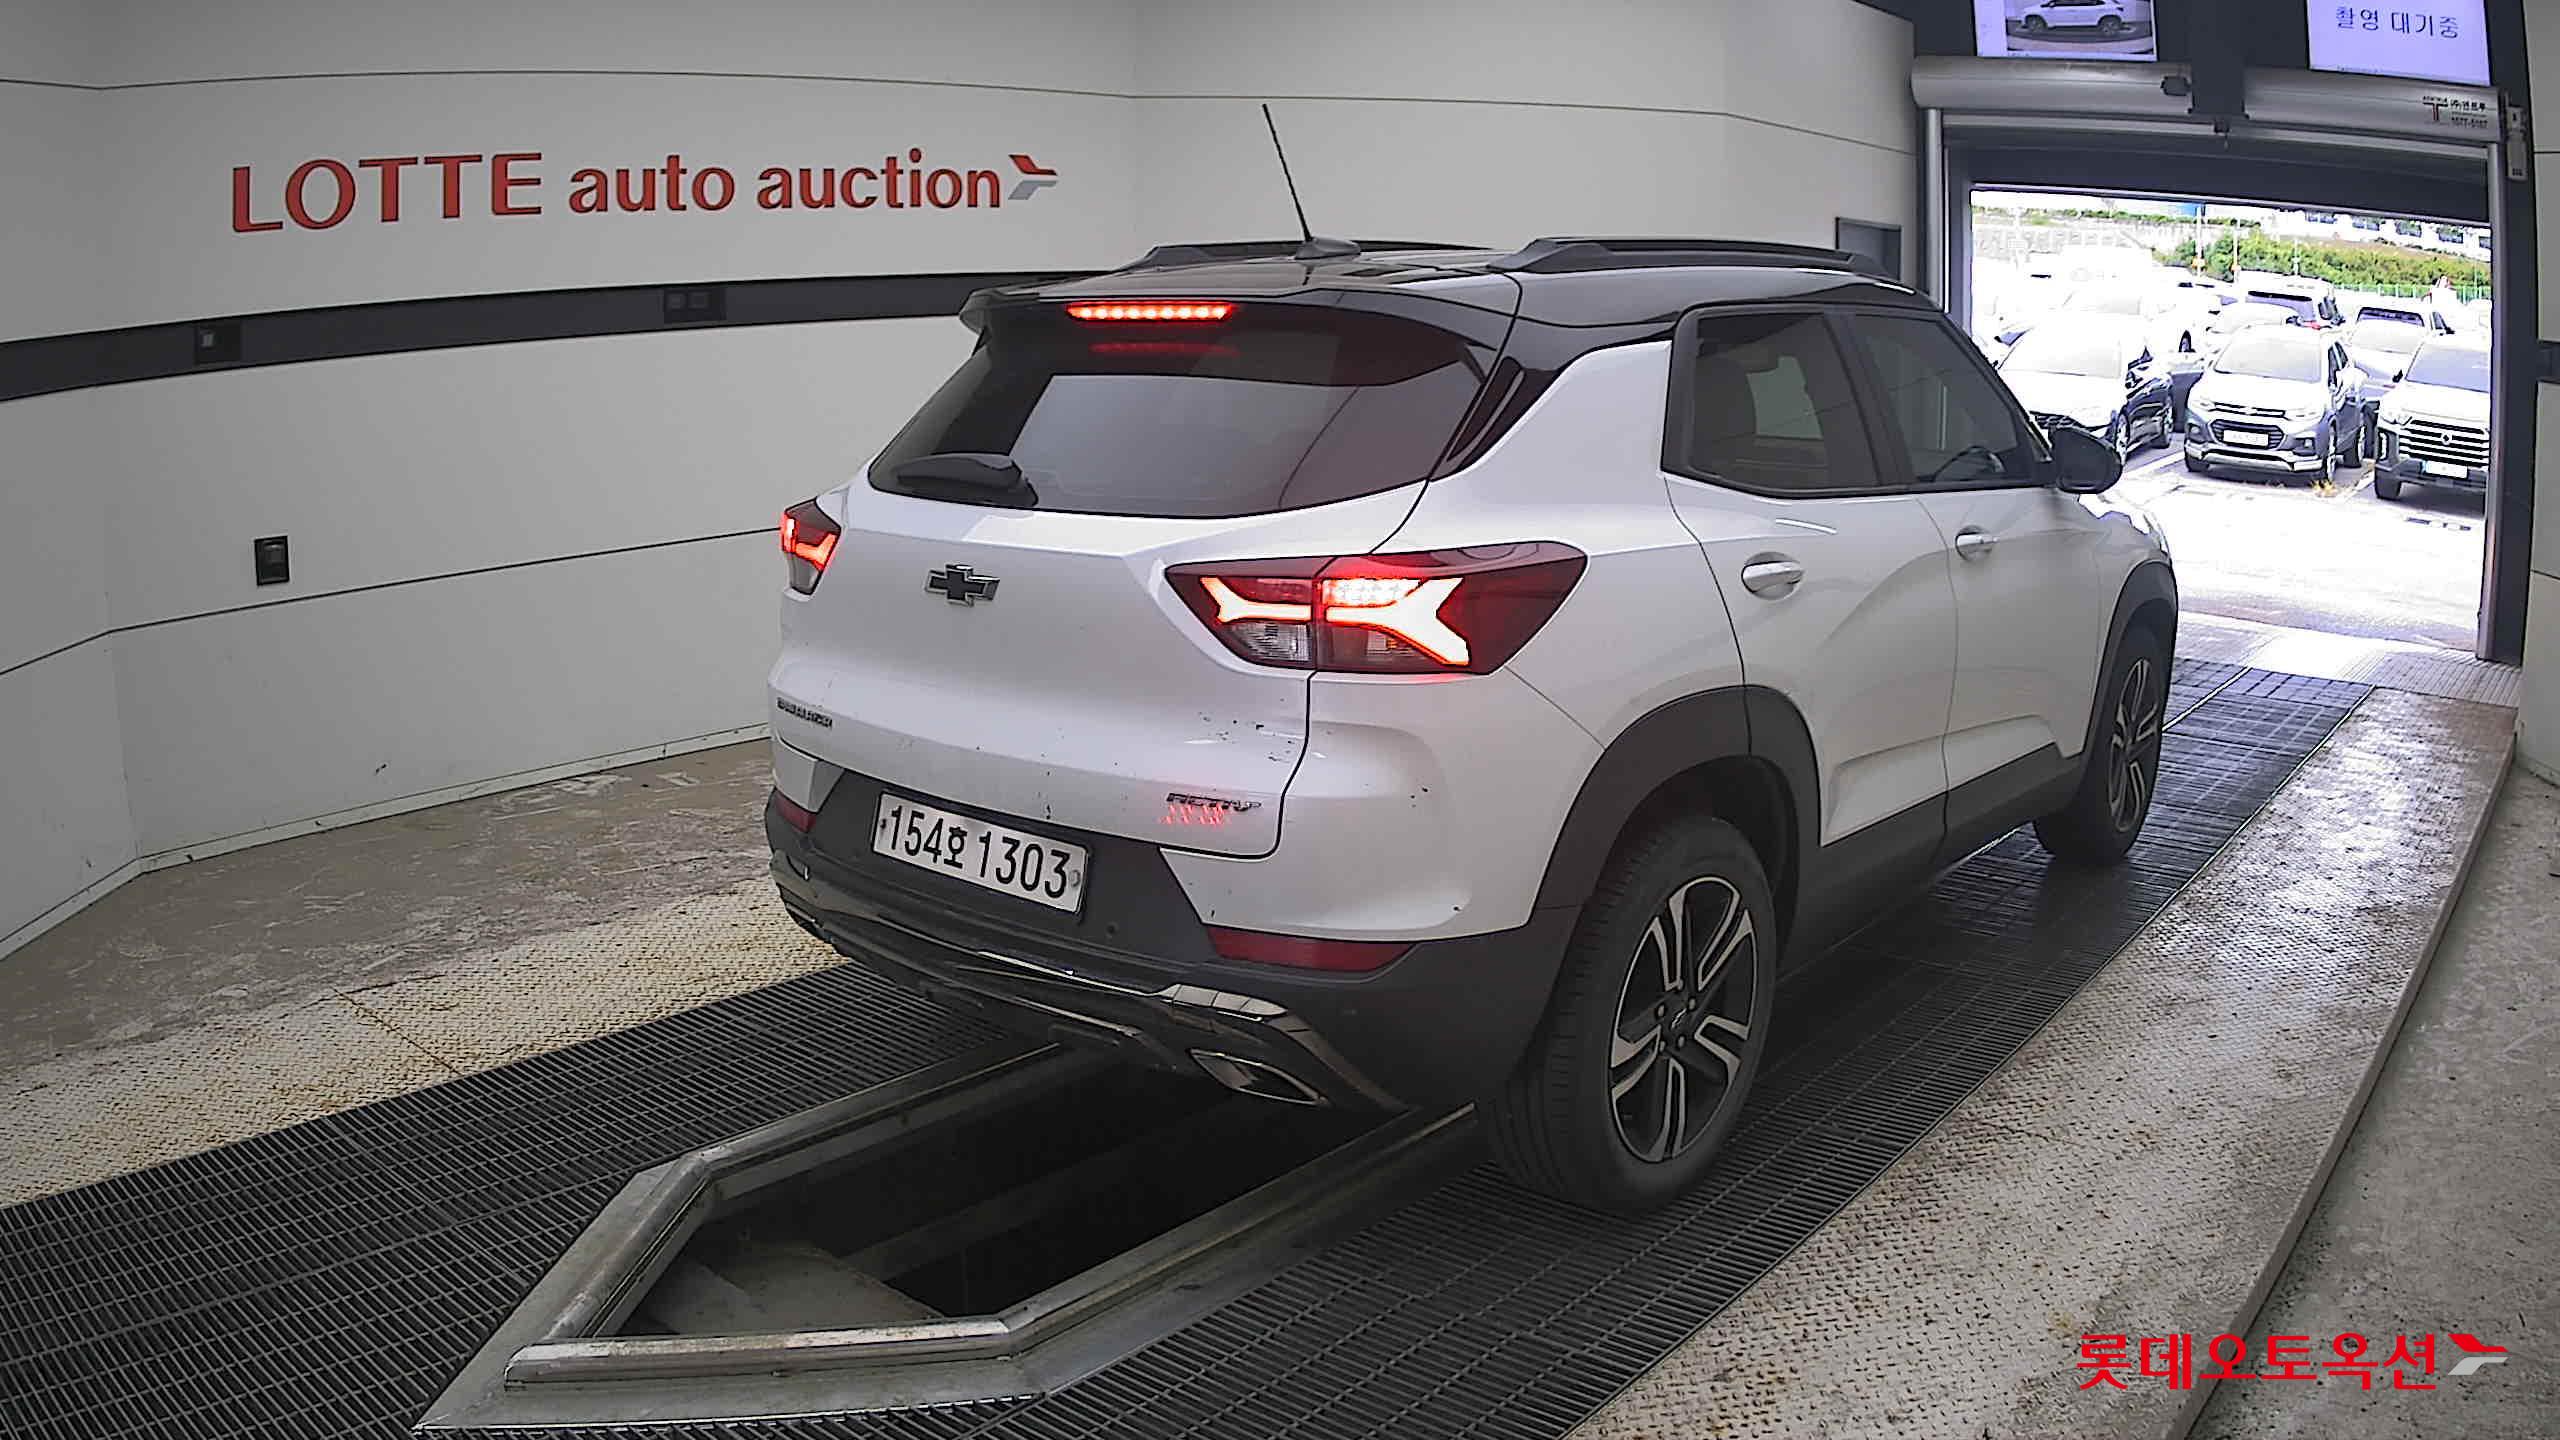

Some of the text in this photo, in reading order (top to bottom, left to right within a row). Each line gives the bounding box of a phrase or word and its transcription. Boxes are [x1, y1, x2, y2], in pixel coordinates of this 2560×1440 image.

[2336, 6, 2459, 39] 촬영 대기중
[232, 148, 1001, 232] LOTTE auto auction
[890, 805, 1071, 899] 154호 1303
